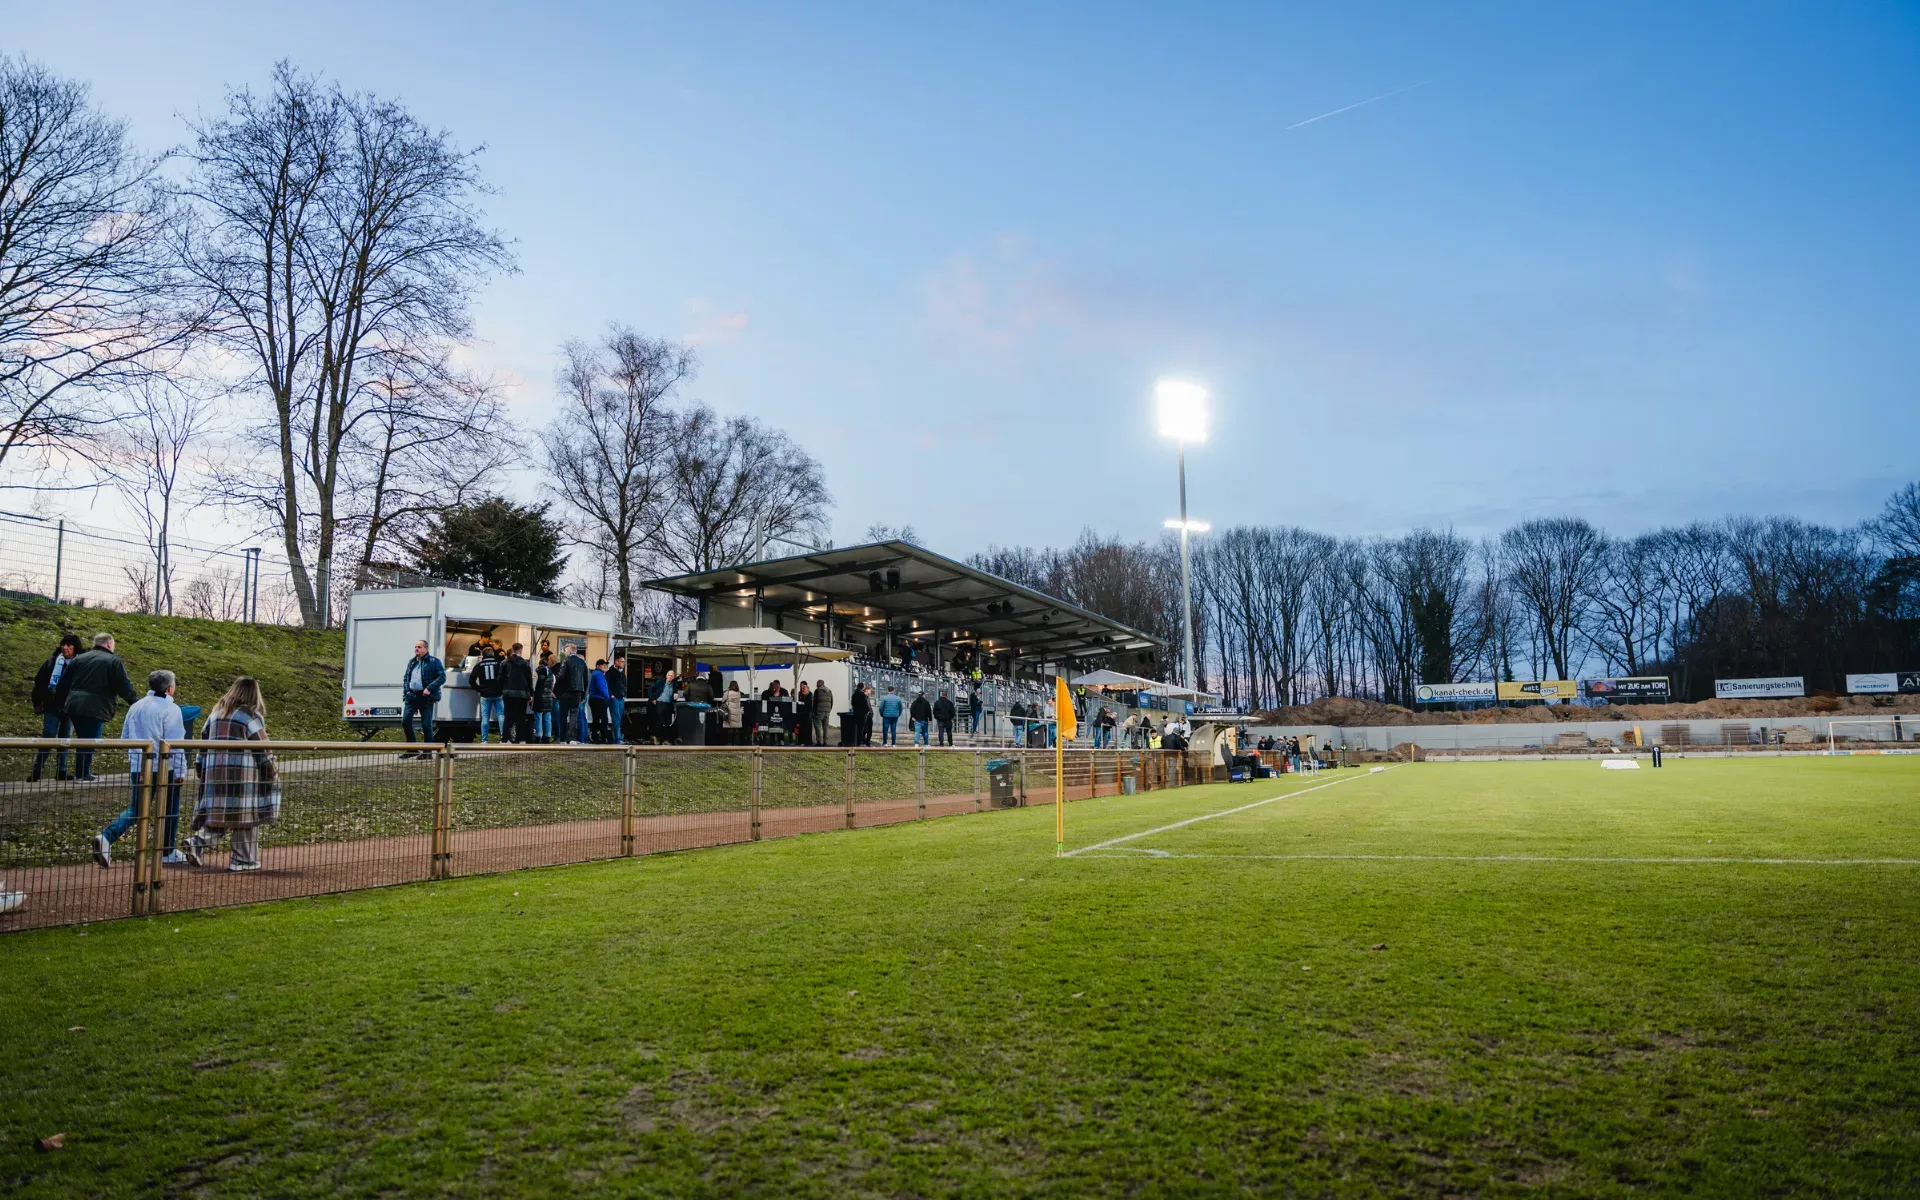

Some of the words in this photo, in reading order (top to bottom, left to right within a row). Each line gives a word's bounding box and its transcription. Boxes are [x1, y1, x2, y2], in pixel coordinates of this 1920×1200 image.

[484, 665, 495, 680] 11
[1627, 682, 1640, 690] ZUG
[1732, 681, 1802, 690] Sanierungstechnik
[1434, 688, 1493, 697] kanal-check.de
